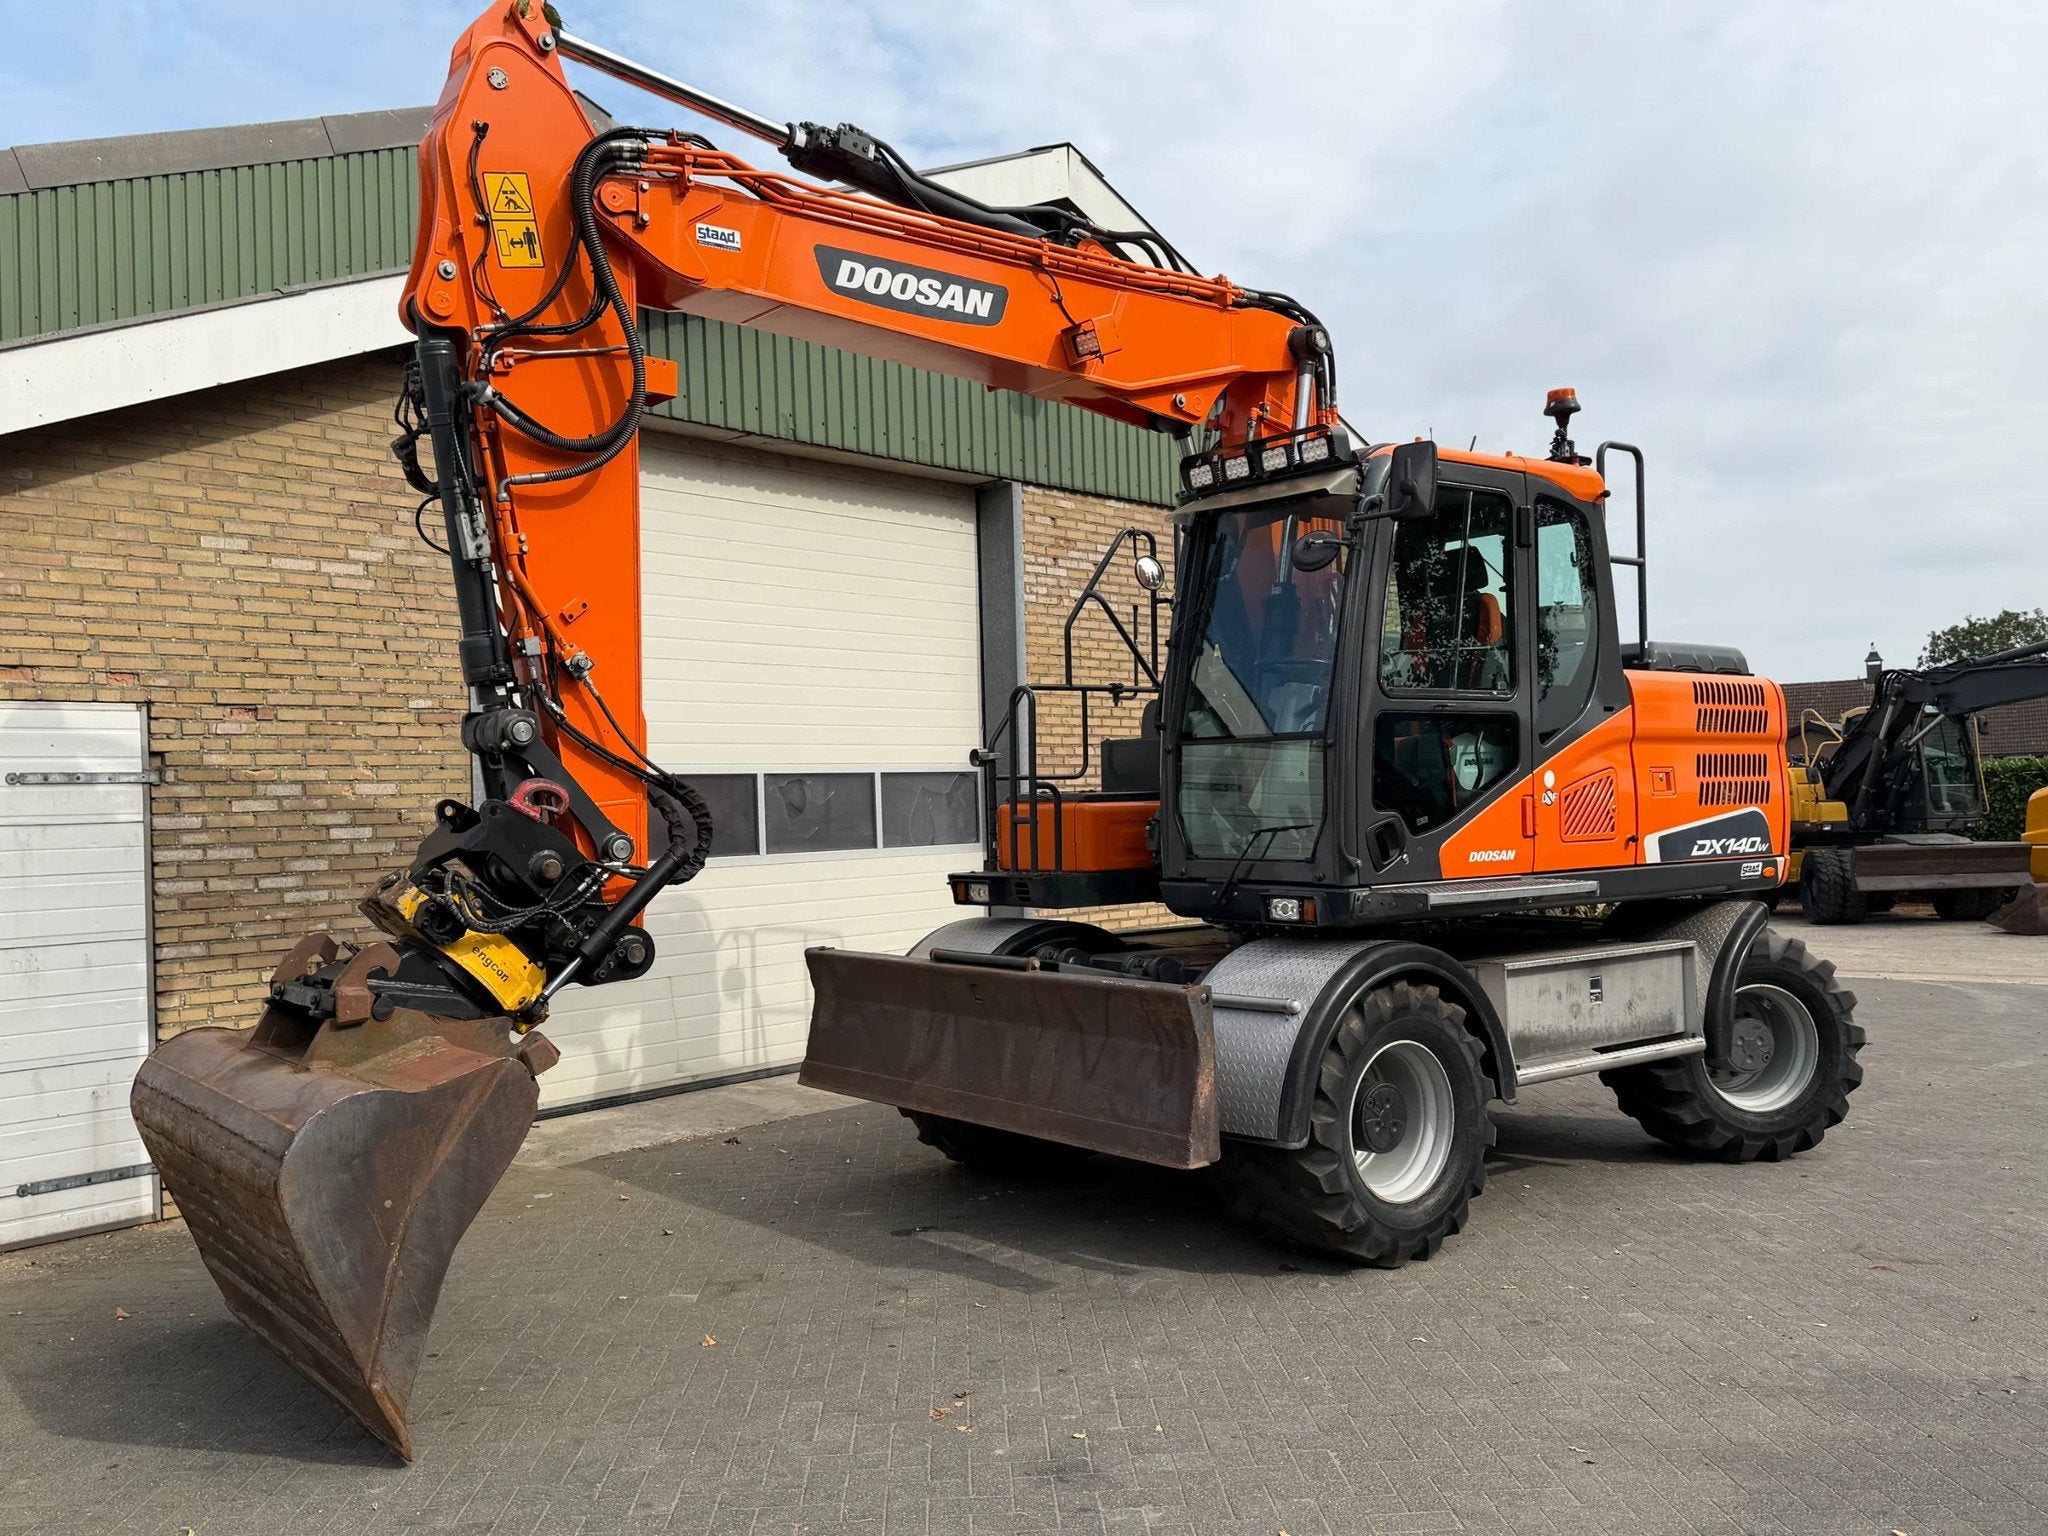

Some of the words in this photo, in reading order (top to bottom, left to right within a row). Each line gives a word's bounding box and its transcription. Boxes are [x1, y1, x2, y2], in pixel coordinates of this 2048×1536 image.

[835, 259, 994, 318] DOOSAN
[1468, 849, 1516, 862] DOOSAN
[471, 946, 509, 983] engcon
